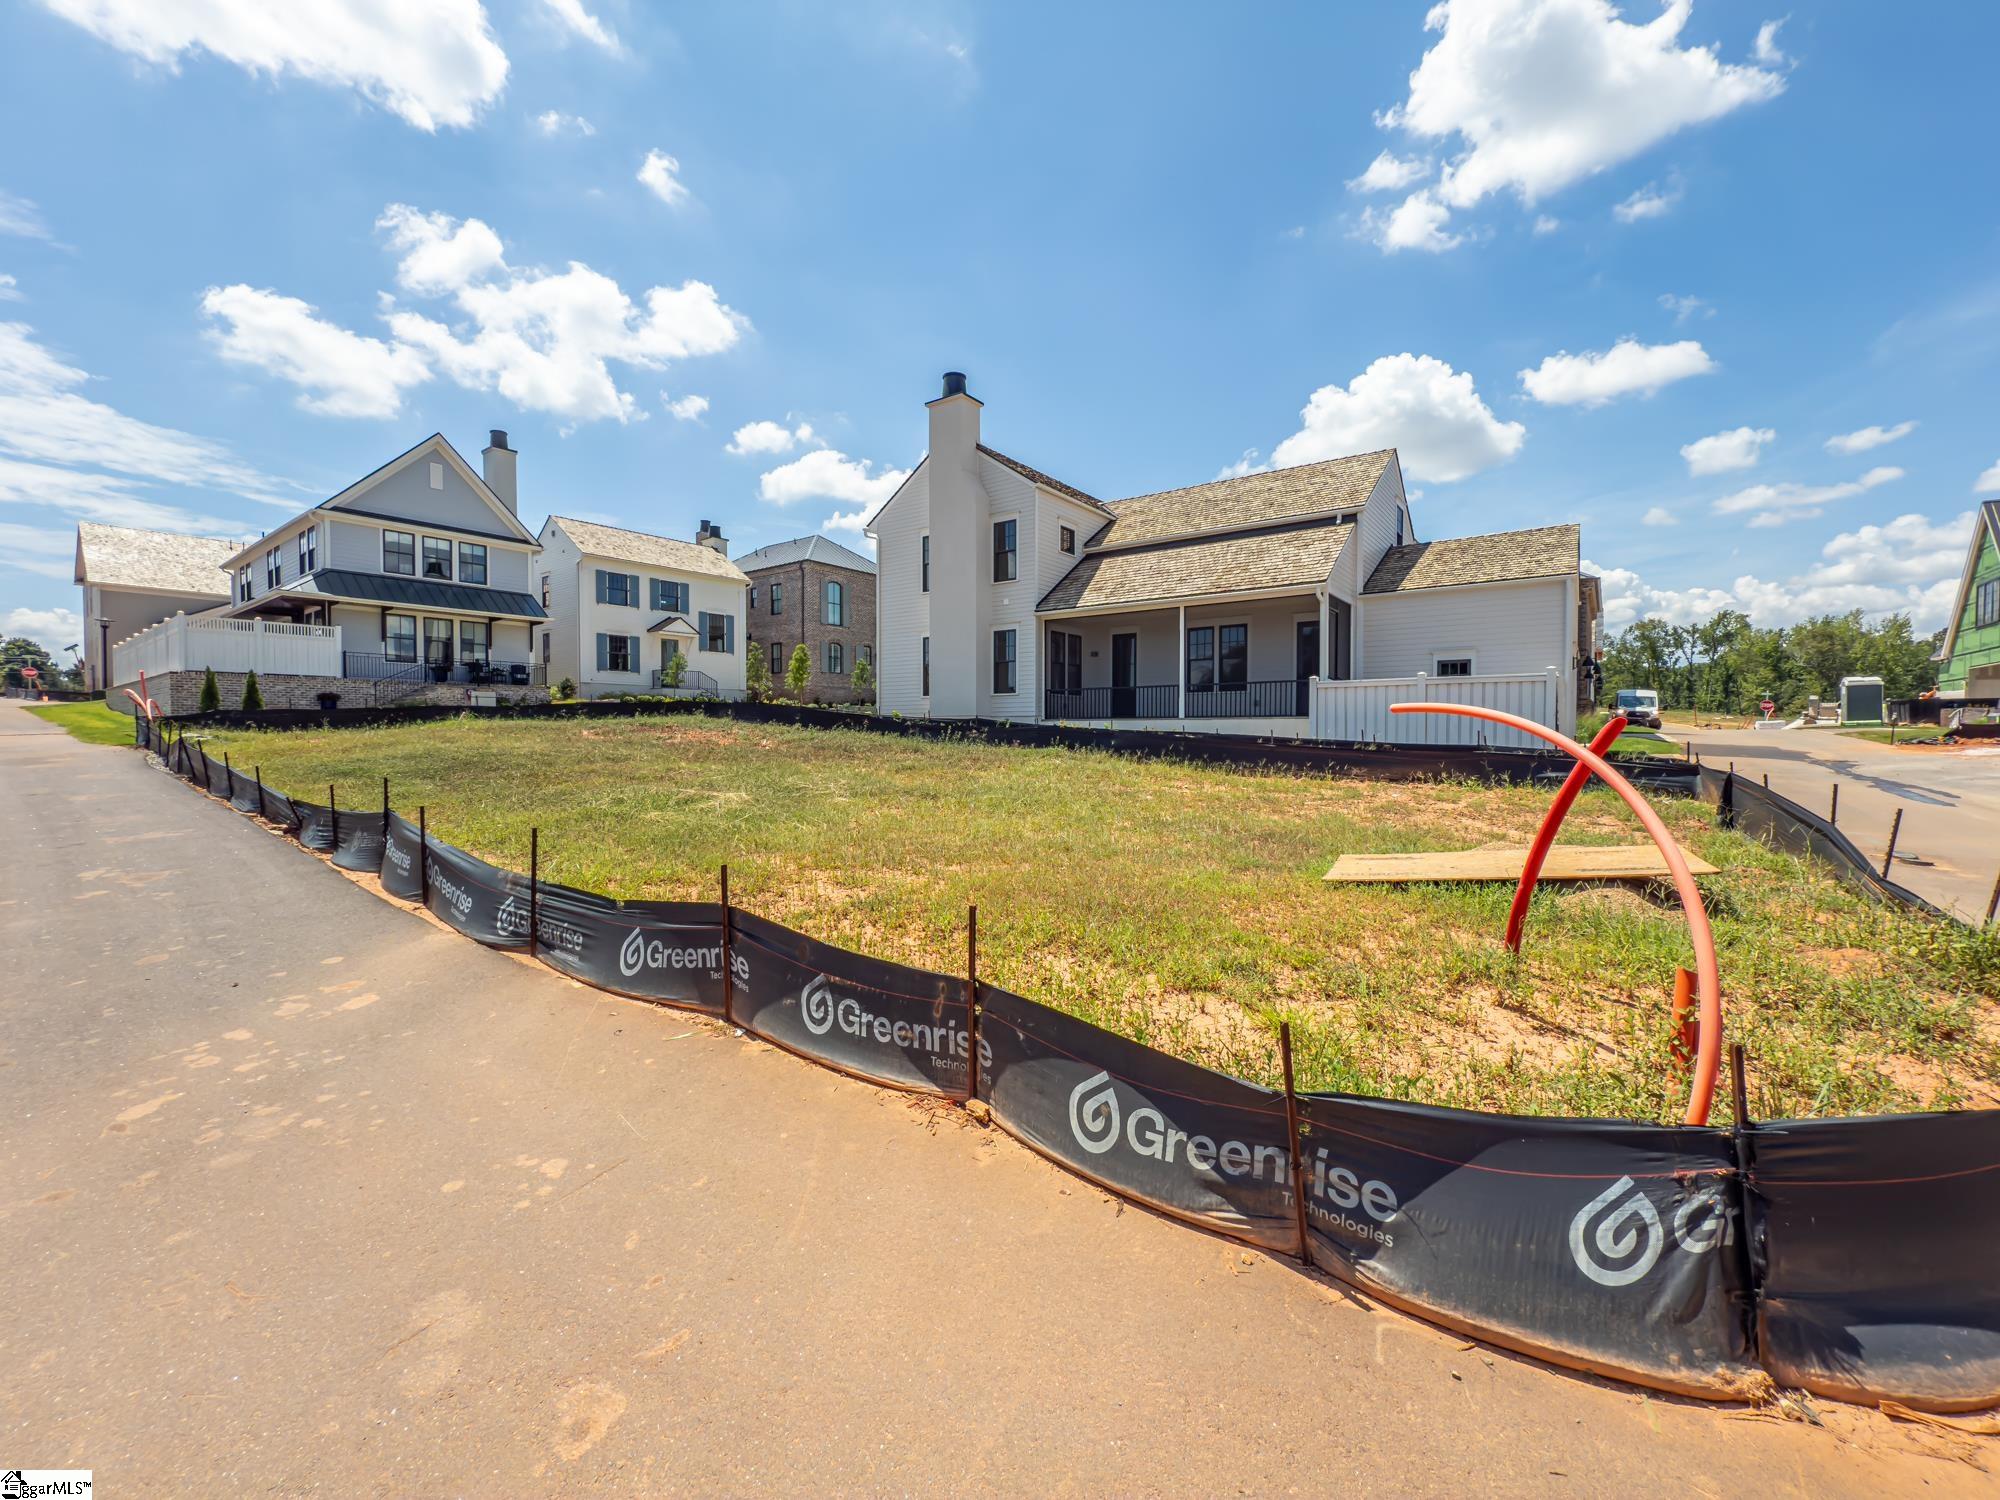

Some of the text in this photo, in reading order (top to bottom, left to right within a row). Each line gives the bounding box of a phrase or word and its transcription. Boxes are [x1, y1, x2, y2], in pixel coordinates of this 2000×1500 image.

[433, 865, 473, 913] Greenrise
[837, 999, 993, 1068] Greenrise
[930, 1055, 992, 1085] Technolies
